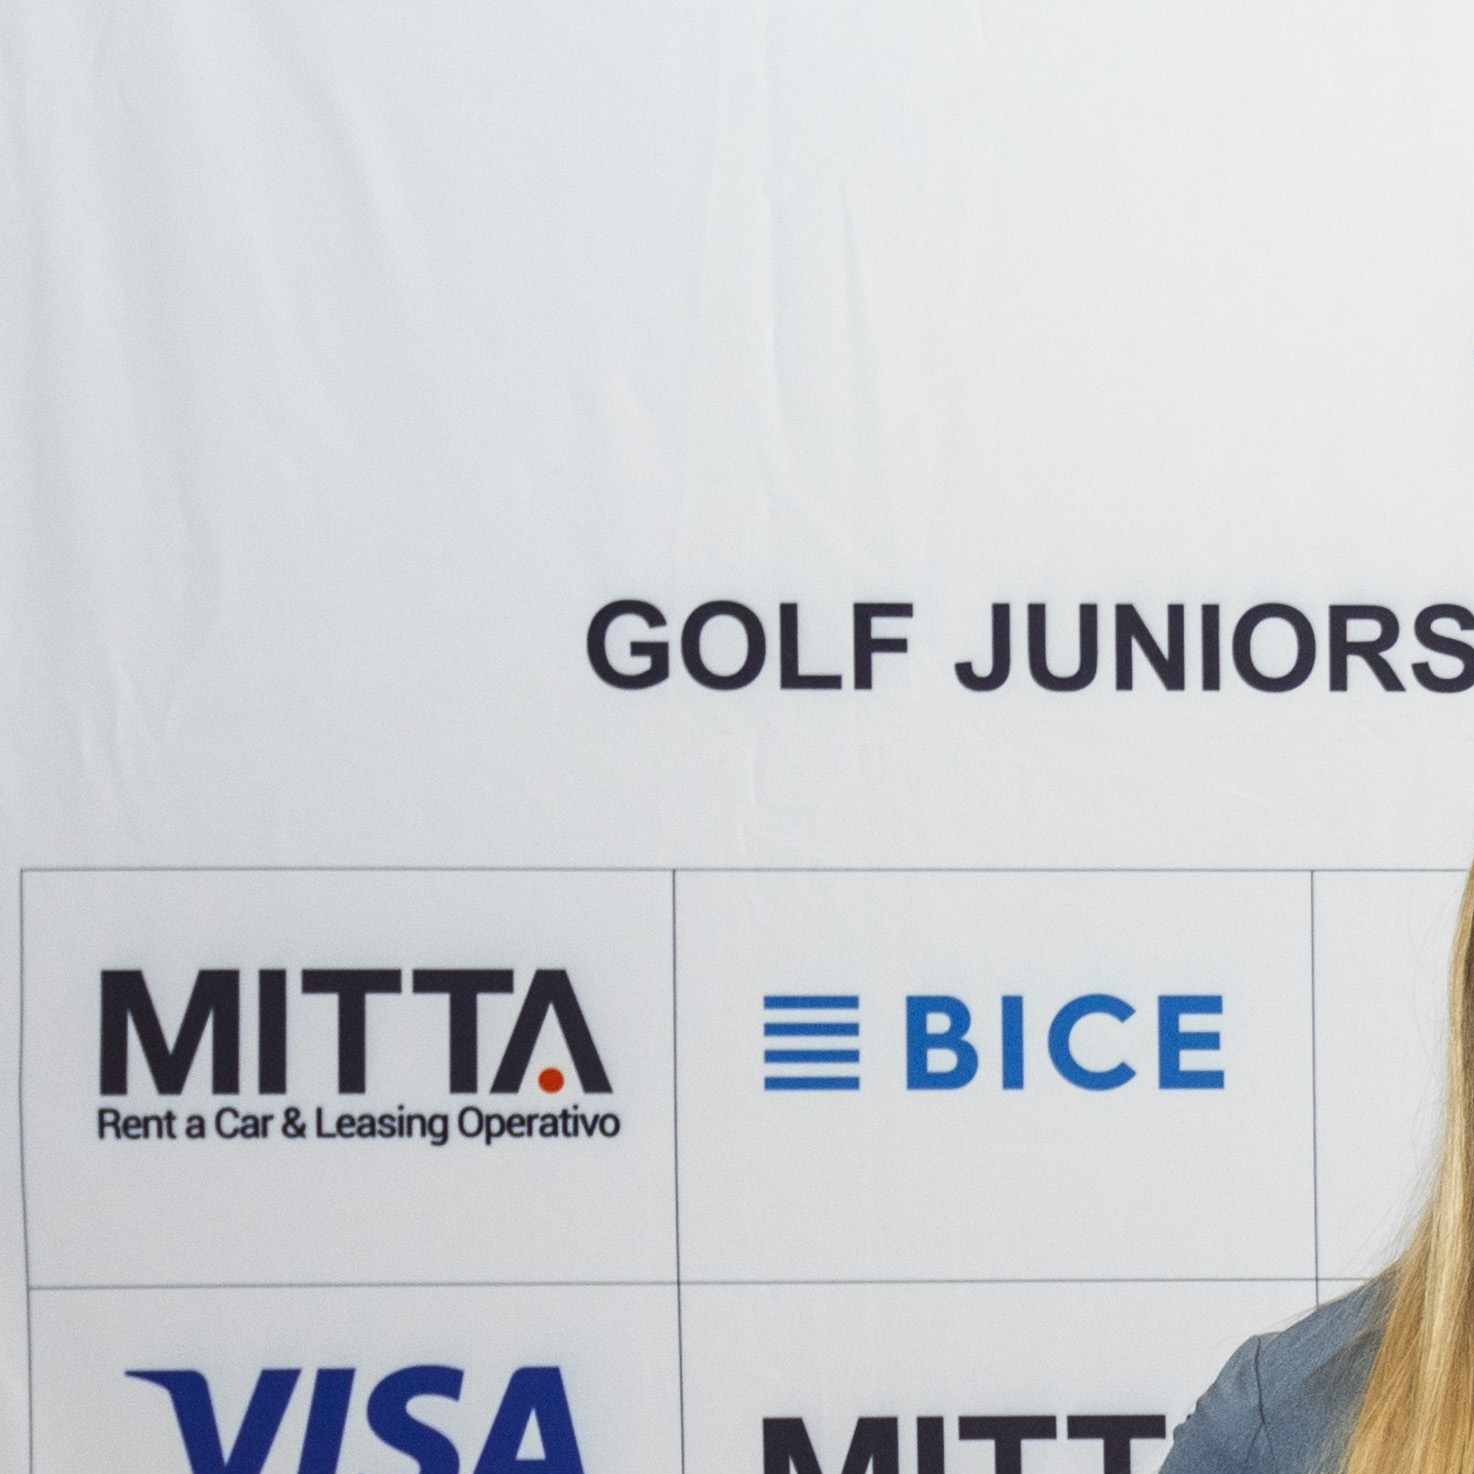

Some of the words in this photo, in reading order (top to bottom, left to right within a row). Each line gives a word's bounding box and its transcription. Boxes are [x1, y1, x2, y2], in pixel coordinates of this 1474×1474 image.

[586, 598, 914, 692] GOLF
[99, 968, 613, 1097] MITTA
[905, 993, 1225, 1092] BICE
[97, 1107, 178, 1140] Rent
[185, 1114, 206, 1140] a
[214, 1106, 275, 1140] Car
[281, 1106, 307, 1139] &
[315, 1104, 450, 1147] Leasing
[457, 1104, 621, 1146] Operativo
